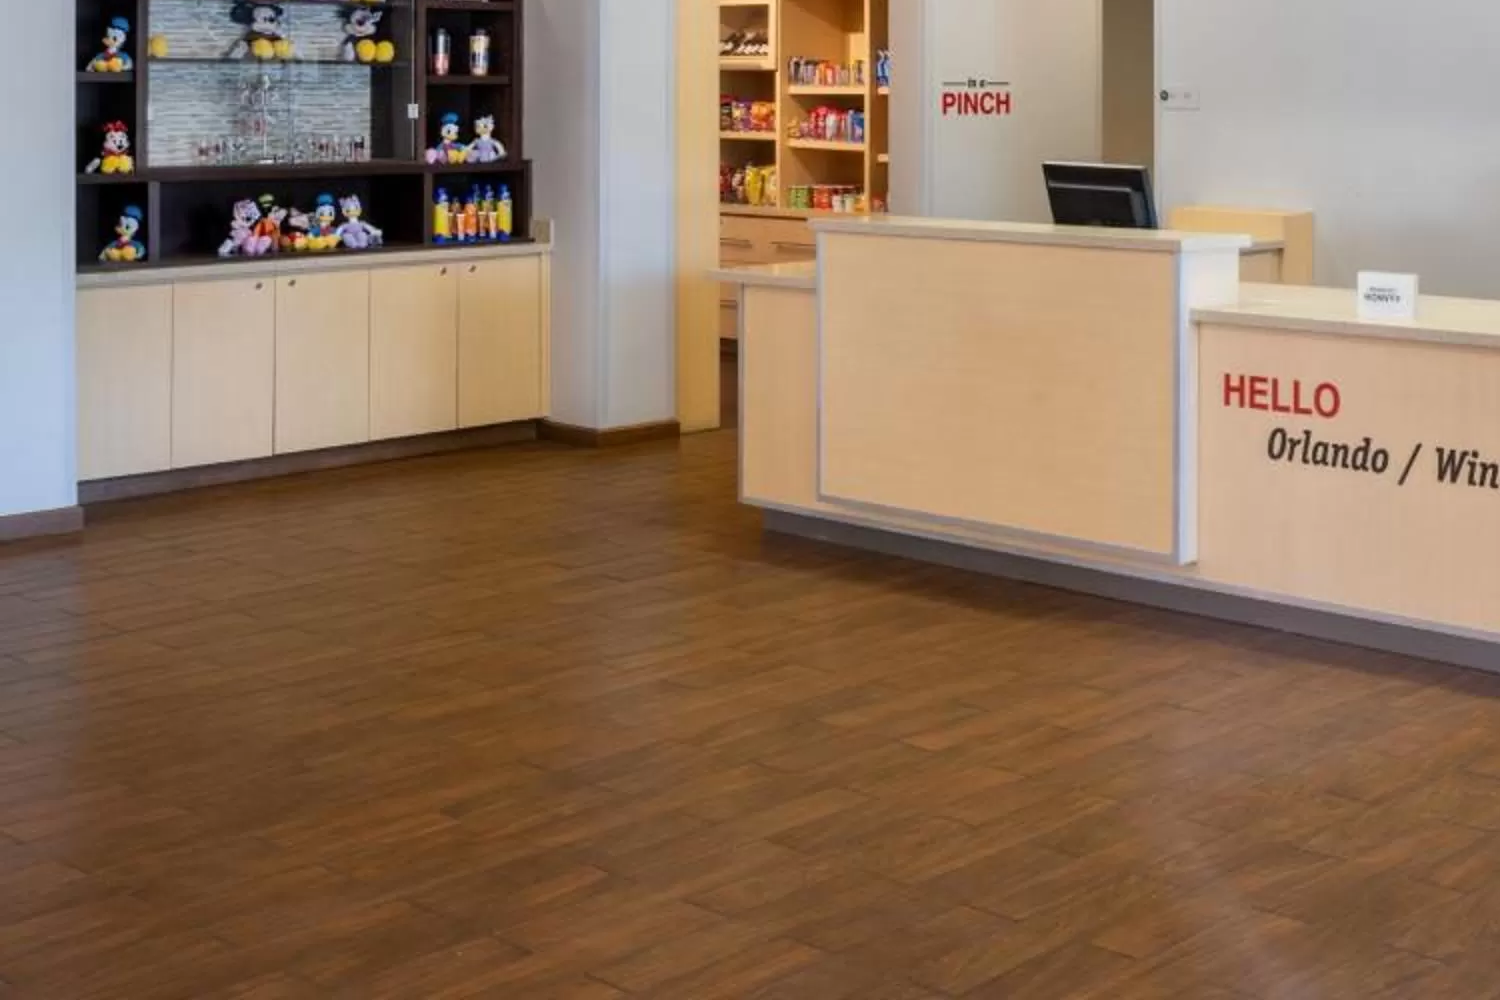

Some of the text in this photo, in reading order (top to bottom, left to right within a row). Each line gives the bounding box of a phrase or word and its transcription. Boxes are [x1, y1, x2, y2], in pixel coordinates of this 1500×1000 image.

[942, 91, 1011, 116] PINCH
[1223, 373, 1341, 418] HELLO
[1267, 427, 1390, 474] Orlando
[1398, 443, 1422, 486] /
